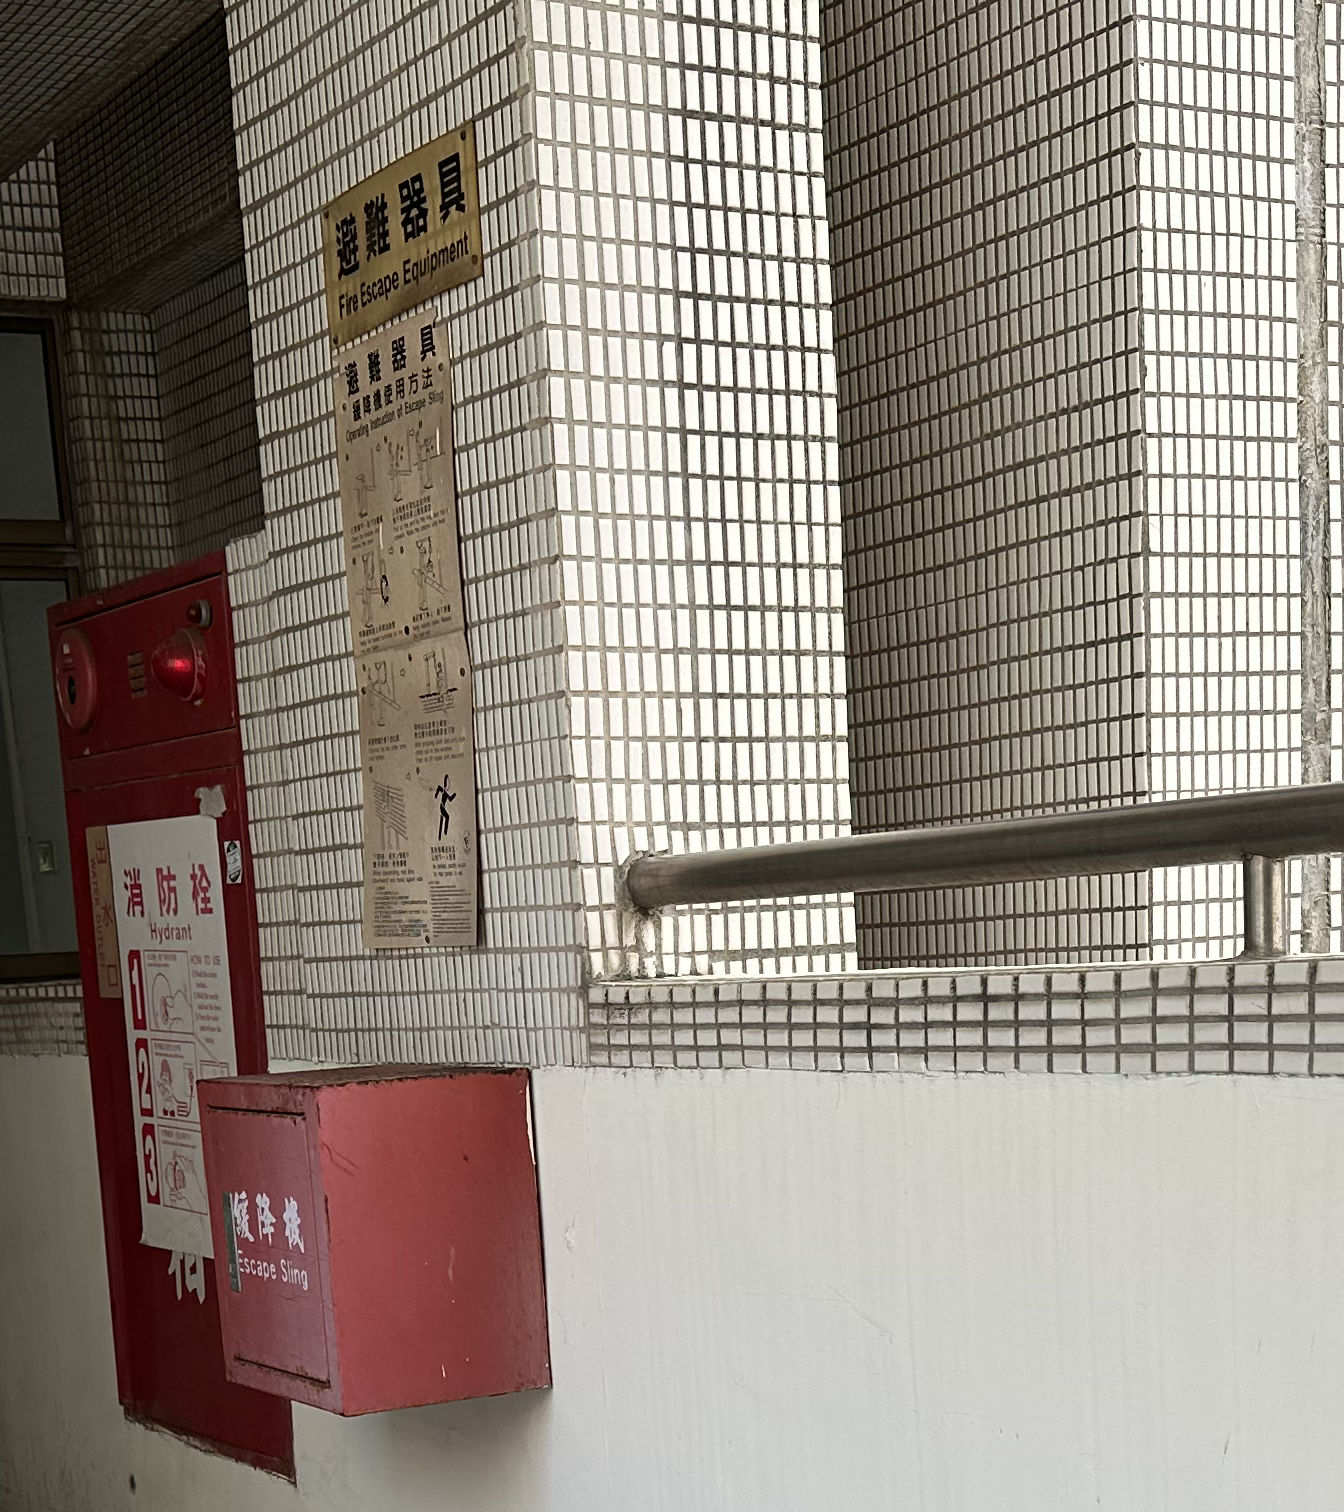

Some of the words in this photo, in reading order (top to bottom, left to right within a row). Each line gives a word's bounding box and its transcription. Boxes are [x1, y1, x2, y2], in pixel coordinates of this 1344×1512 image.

[336, 152, 466, 281] 避難器具
[339, 291, 358, 320] Fire
[360, 269, 399, 309] Escape
[402, 232, 469, 286] Equipment
[344, 323, 436, 397] 避難器具
[352, 366, 433, 422] 緩降機使用方法
[397, 403, 403, 419] of
[404, 398, 426, 415] Escape
[123, 863, 213, 918] 消防栓
[150, 921, 192, 944] Hydrant
[132, 958, 142, 1020] 1
[138, 1047, 152, 1110] 2
[144, 1134, 157, 1197] 3
[232, 1190, 305, 1254] 緩降機
[237, 1249, 277, 1282] Escape
[280, 1258, 309, 1291] Sling
